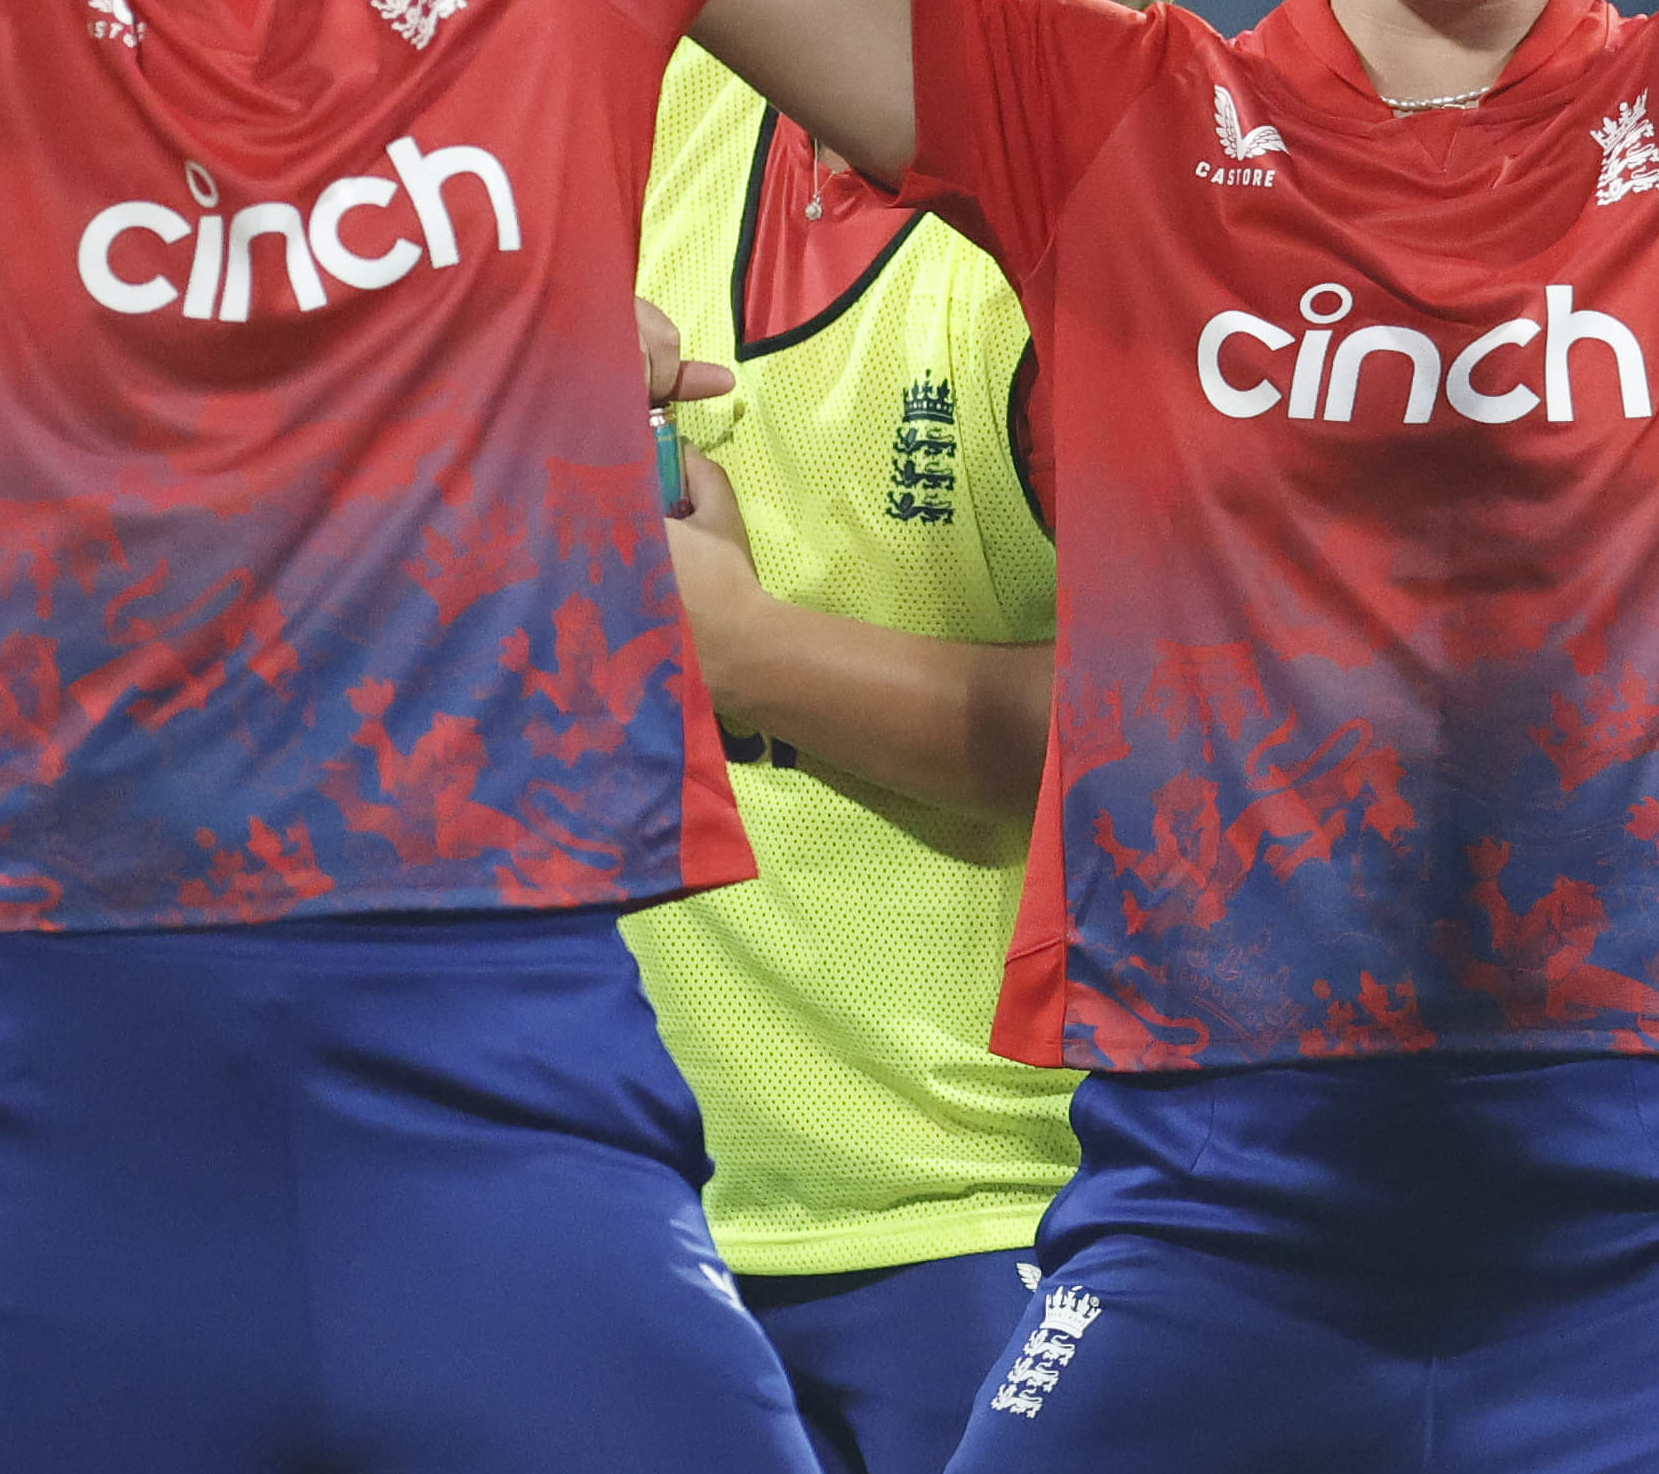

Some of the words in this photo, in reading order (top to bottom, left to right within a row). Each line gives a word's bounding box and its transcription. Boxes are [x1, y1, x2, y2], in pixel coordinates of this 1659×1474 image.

[77, 135, 523, 323] cinch
[1195, 161, 1278, 187] CASTORE
[1197, 282, 1654, 424] cinch
